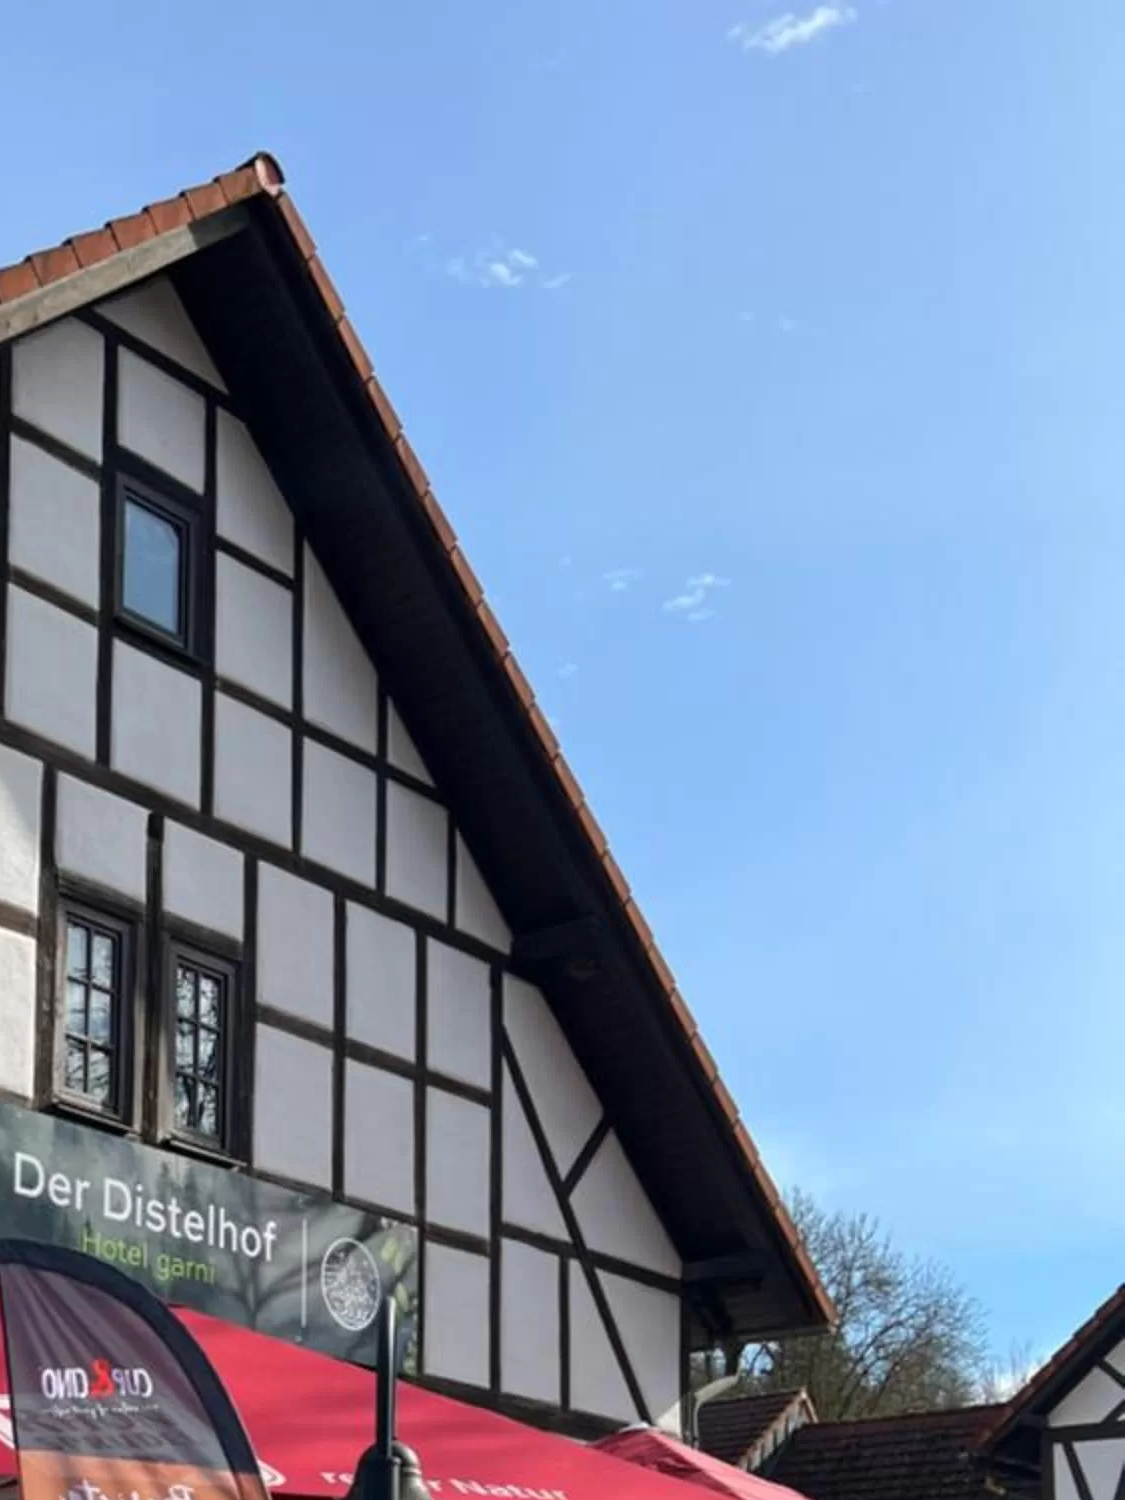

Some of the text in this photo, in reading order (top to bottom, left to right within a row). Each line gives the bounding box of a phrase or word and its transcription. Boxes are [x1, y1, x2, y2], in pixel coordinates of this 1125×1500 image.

[13, 1152, 277, 1262] Der Distelhof
[82, 1230, 215, 1284] Hotel garni
[450, 1478, 568, 1500] Natur
